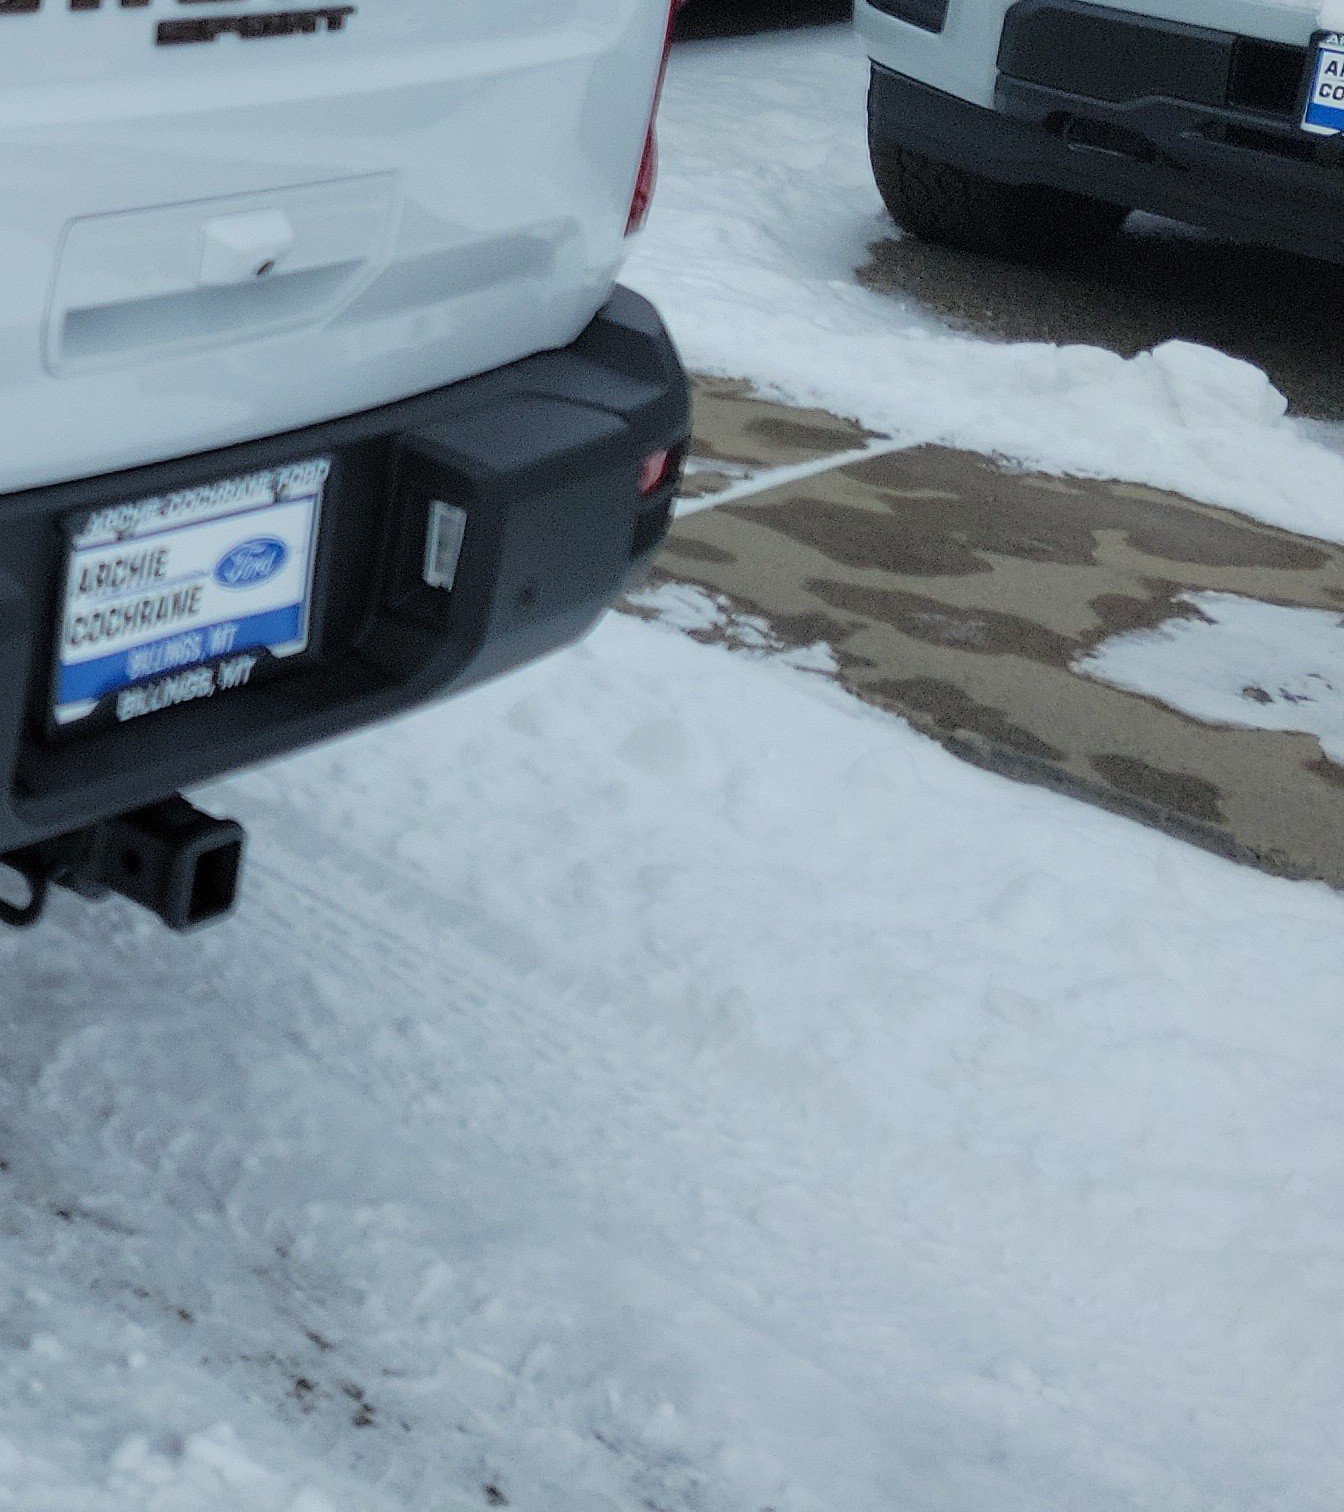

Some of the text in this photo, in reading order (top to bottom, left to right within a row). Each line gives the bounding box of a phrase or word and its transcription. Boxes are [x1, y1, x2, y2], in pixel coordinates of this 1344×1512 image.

[155, 5, 355, 46] SPORT
[79, 548, 168, 593] ARCHIE
[223, 542, 278, 585] Ford
[69, 585, 203, 647] COCHRANE
